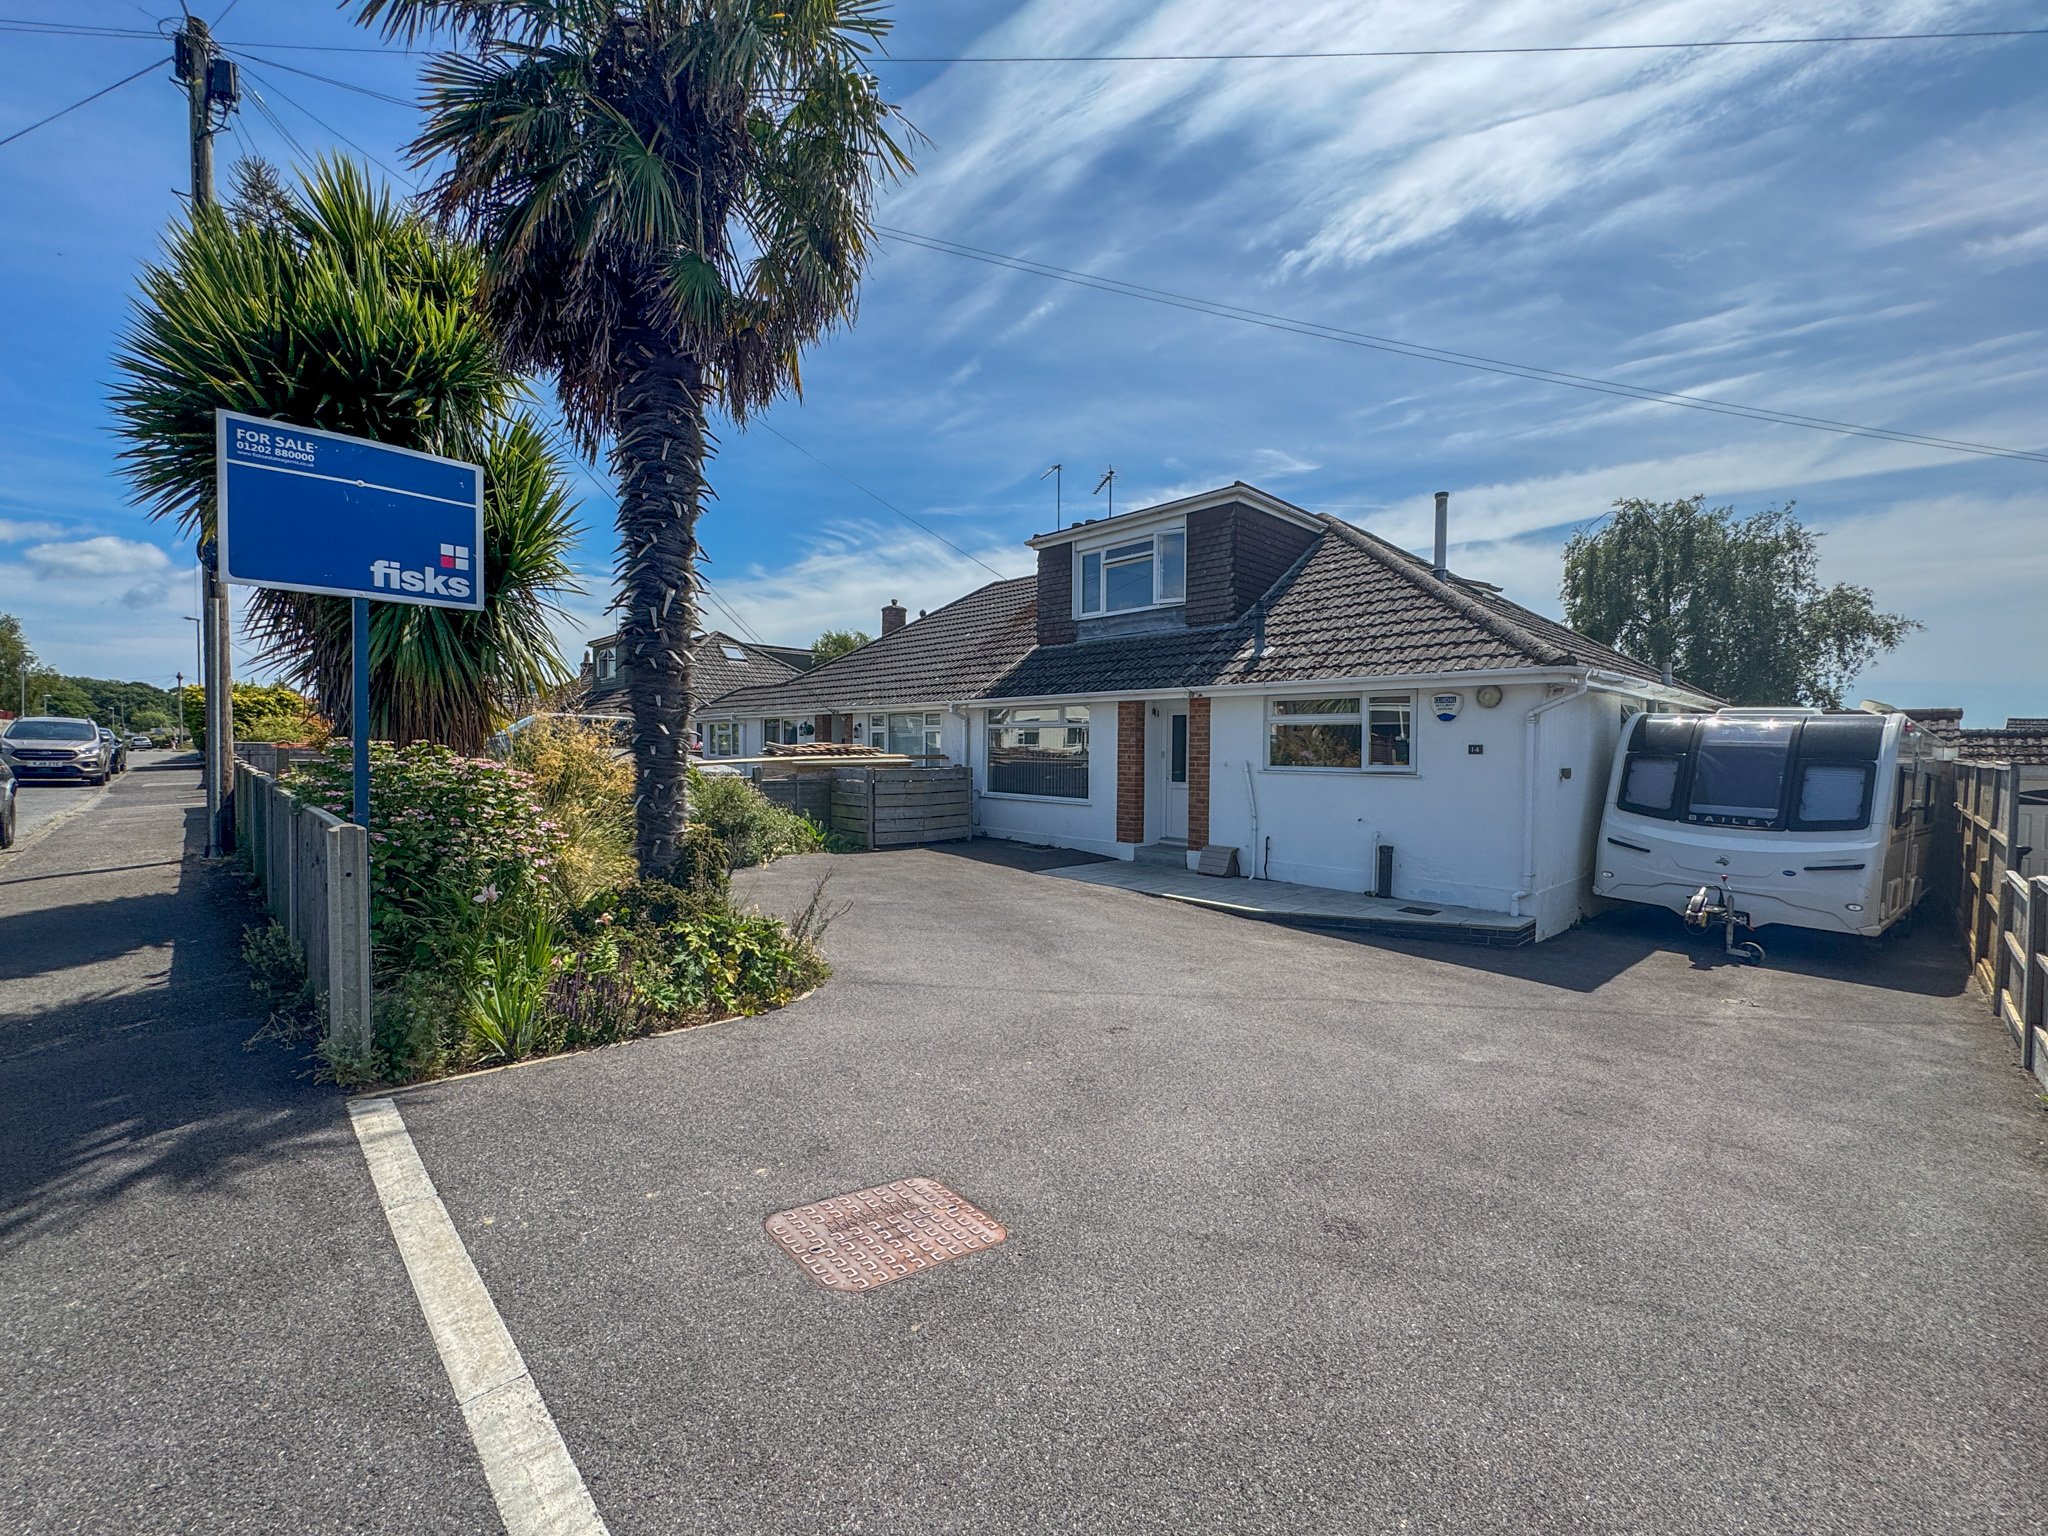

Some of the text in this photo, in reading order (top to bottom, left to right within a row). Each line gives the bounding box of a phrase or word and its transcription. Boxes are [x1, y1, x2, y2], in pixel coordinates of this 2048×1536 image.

[236, 428, 314, 453] FOR SALE
[236, 441, 315, 462] 01202 880000
[370, 560, 470, 597] fisks
[1688, 815, 1774, 827] BAILEY
